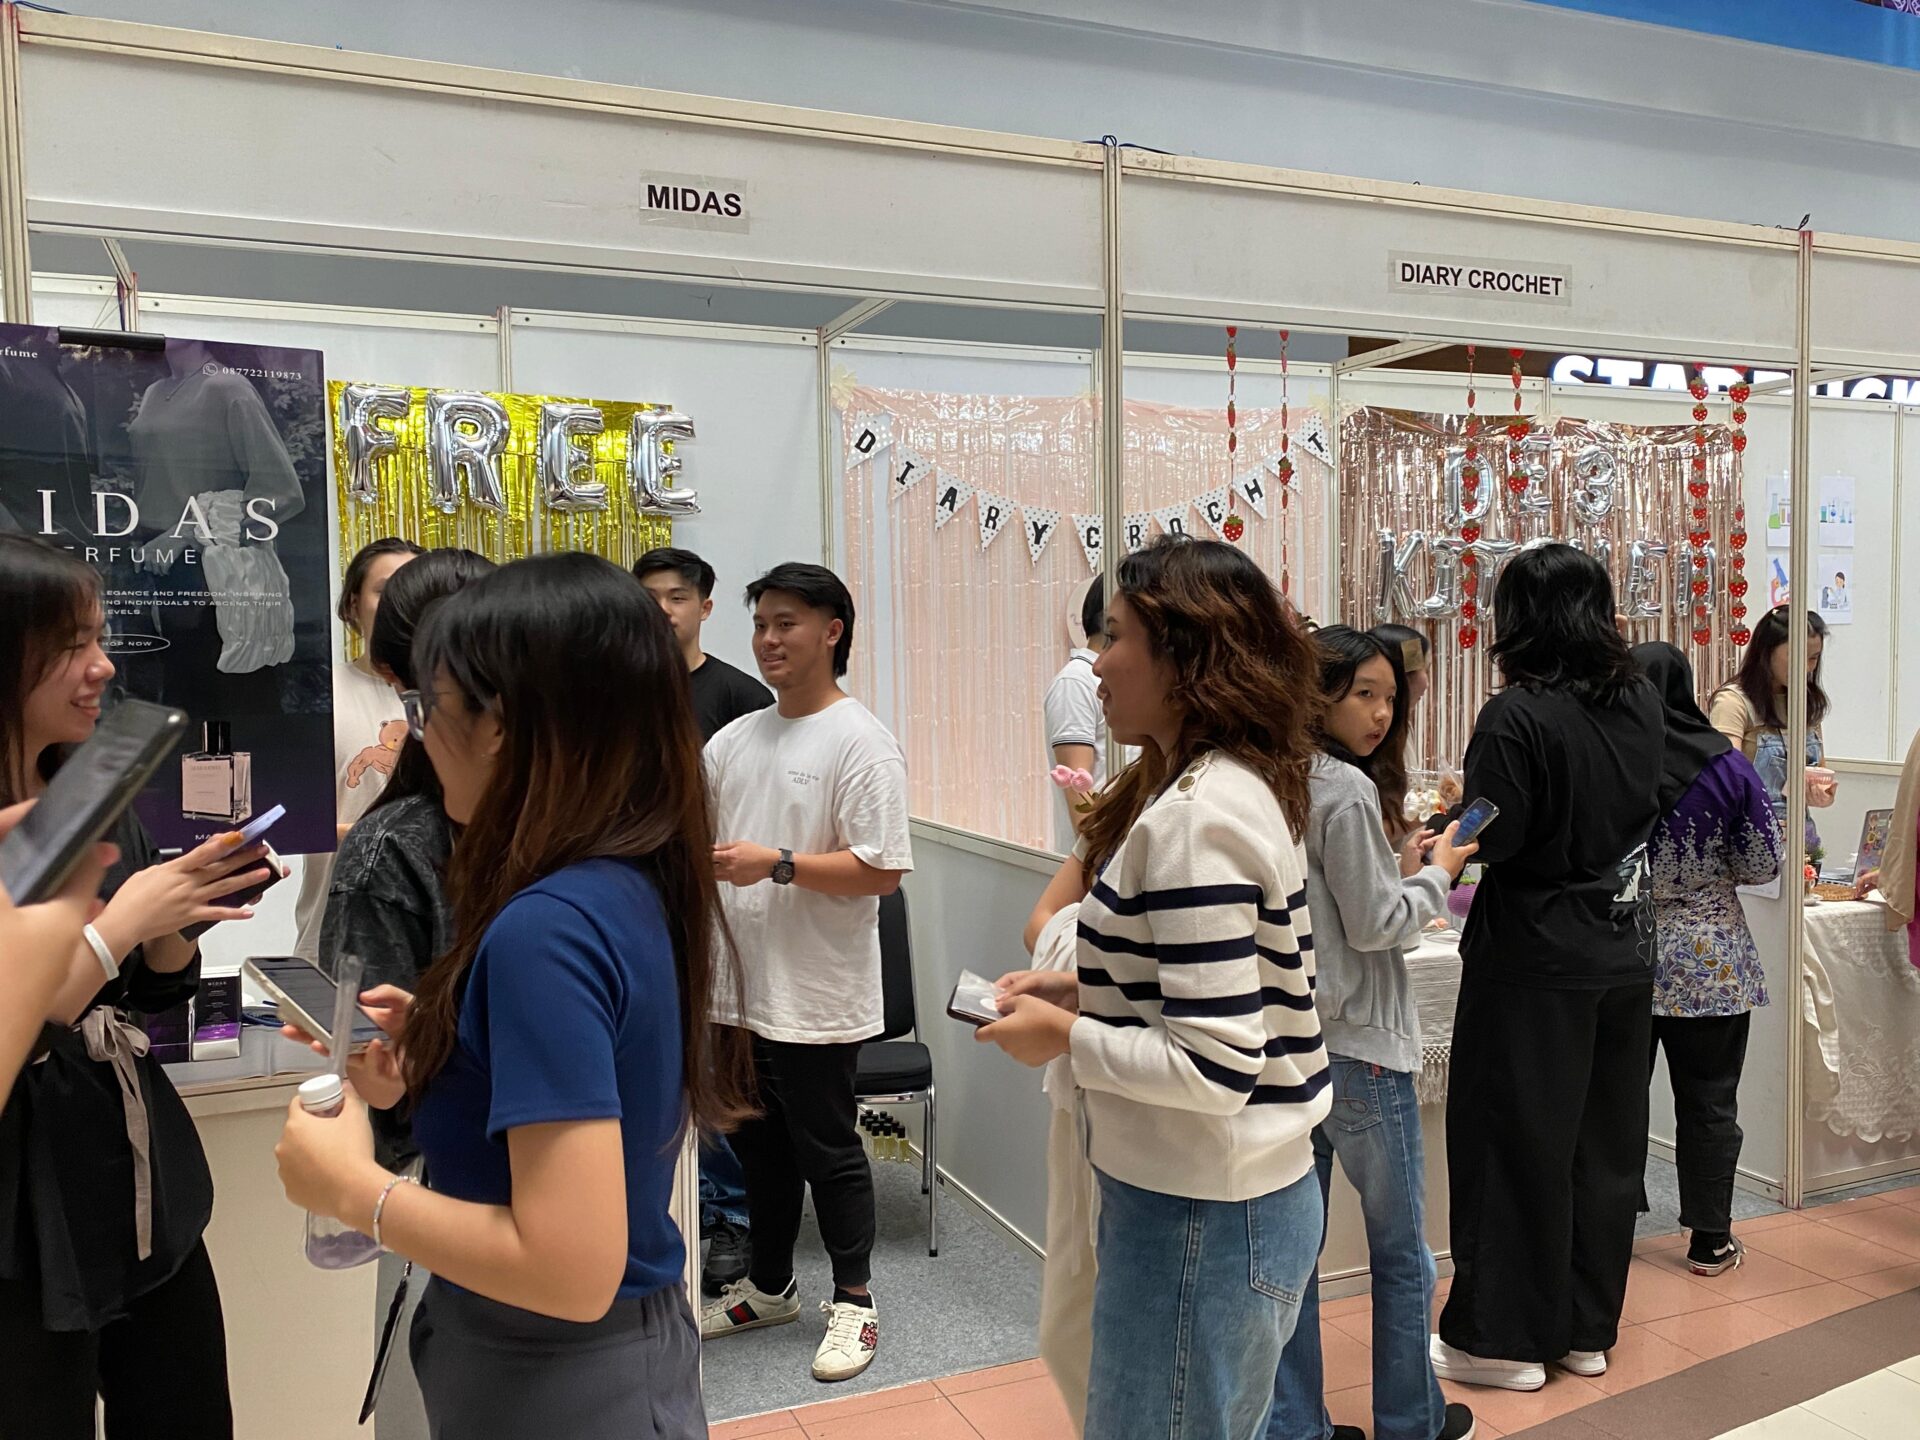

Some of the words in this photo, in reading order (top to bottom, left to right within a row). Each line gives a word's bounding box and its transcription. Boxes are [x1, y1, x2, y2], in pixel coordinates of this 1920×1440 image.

[647, 184, 742, 217] MIDAS
[1401, 262, 1463, 287] DIARY
[1468, 269, 1563, 296] CROCHET
[222, 366, 302, 381] 087722119873
[339, 383, 701, 516] FREE
[854, 428, 1049, 546] DIARY
[1085, 430, 1325, 549] CROCHT
[34, 489, 280, 542] IDAS
[64, 546, 197, 565] RFUME
